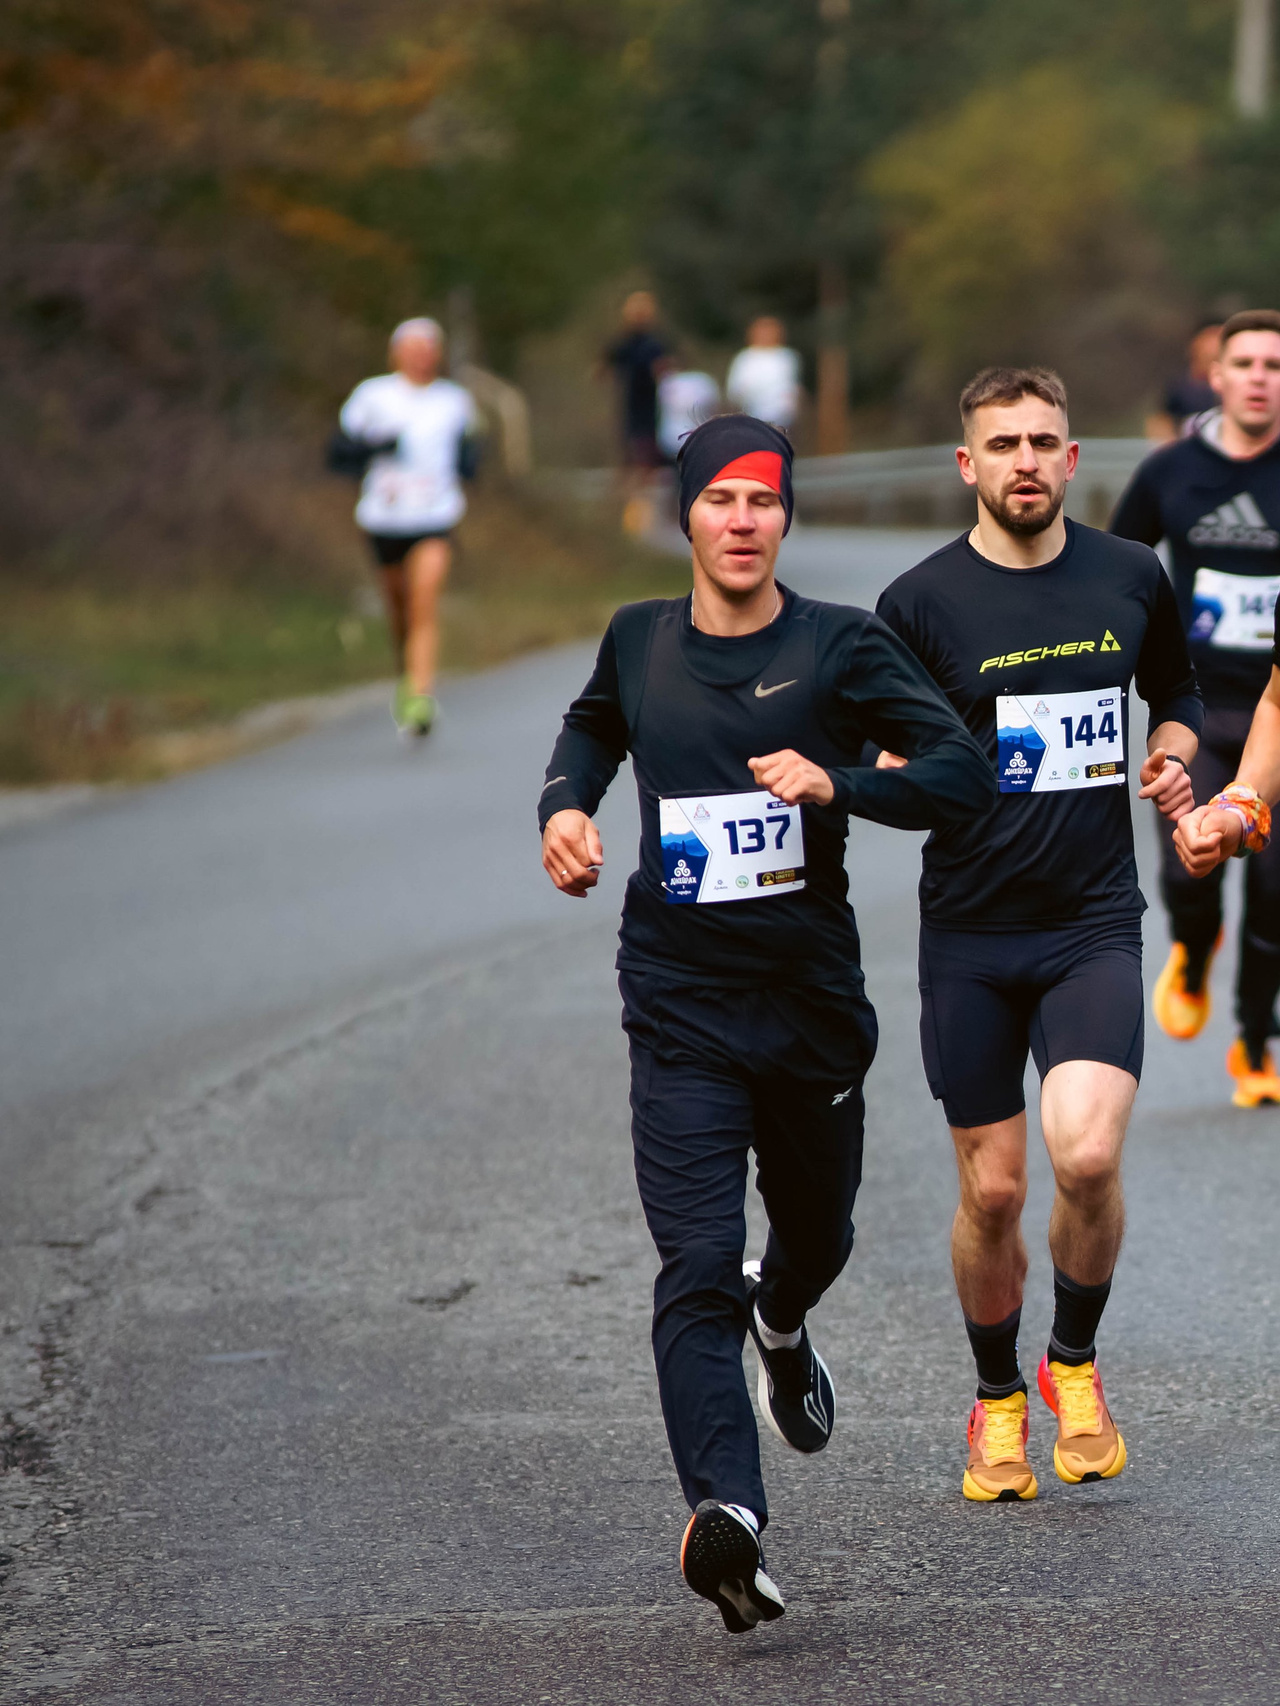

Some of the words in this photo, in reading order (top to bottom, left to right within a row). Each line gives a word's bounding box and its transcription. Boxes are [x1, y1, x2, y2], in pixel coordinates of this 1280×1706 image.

[979, 640, 1096, 673] FISCHER
[1060, 711, 1118, 749] 144
[722, 814, 791, 855] 137
